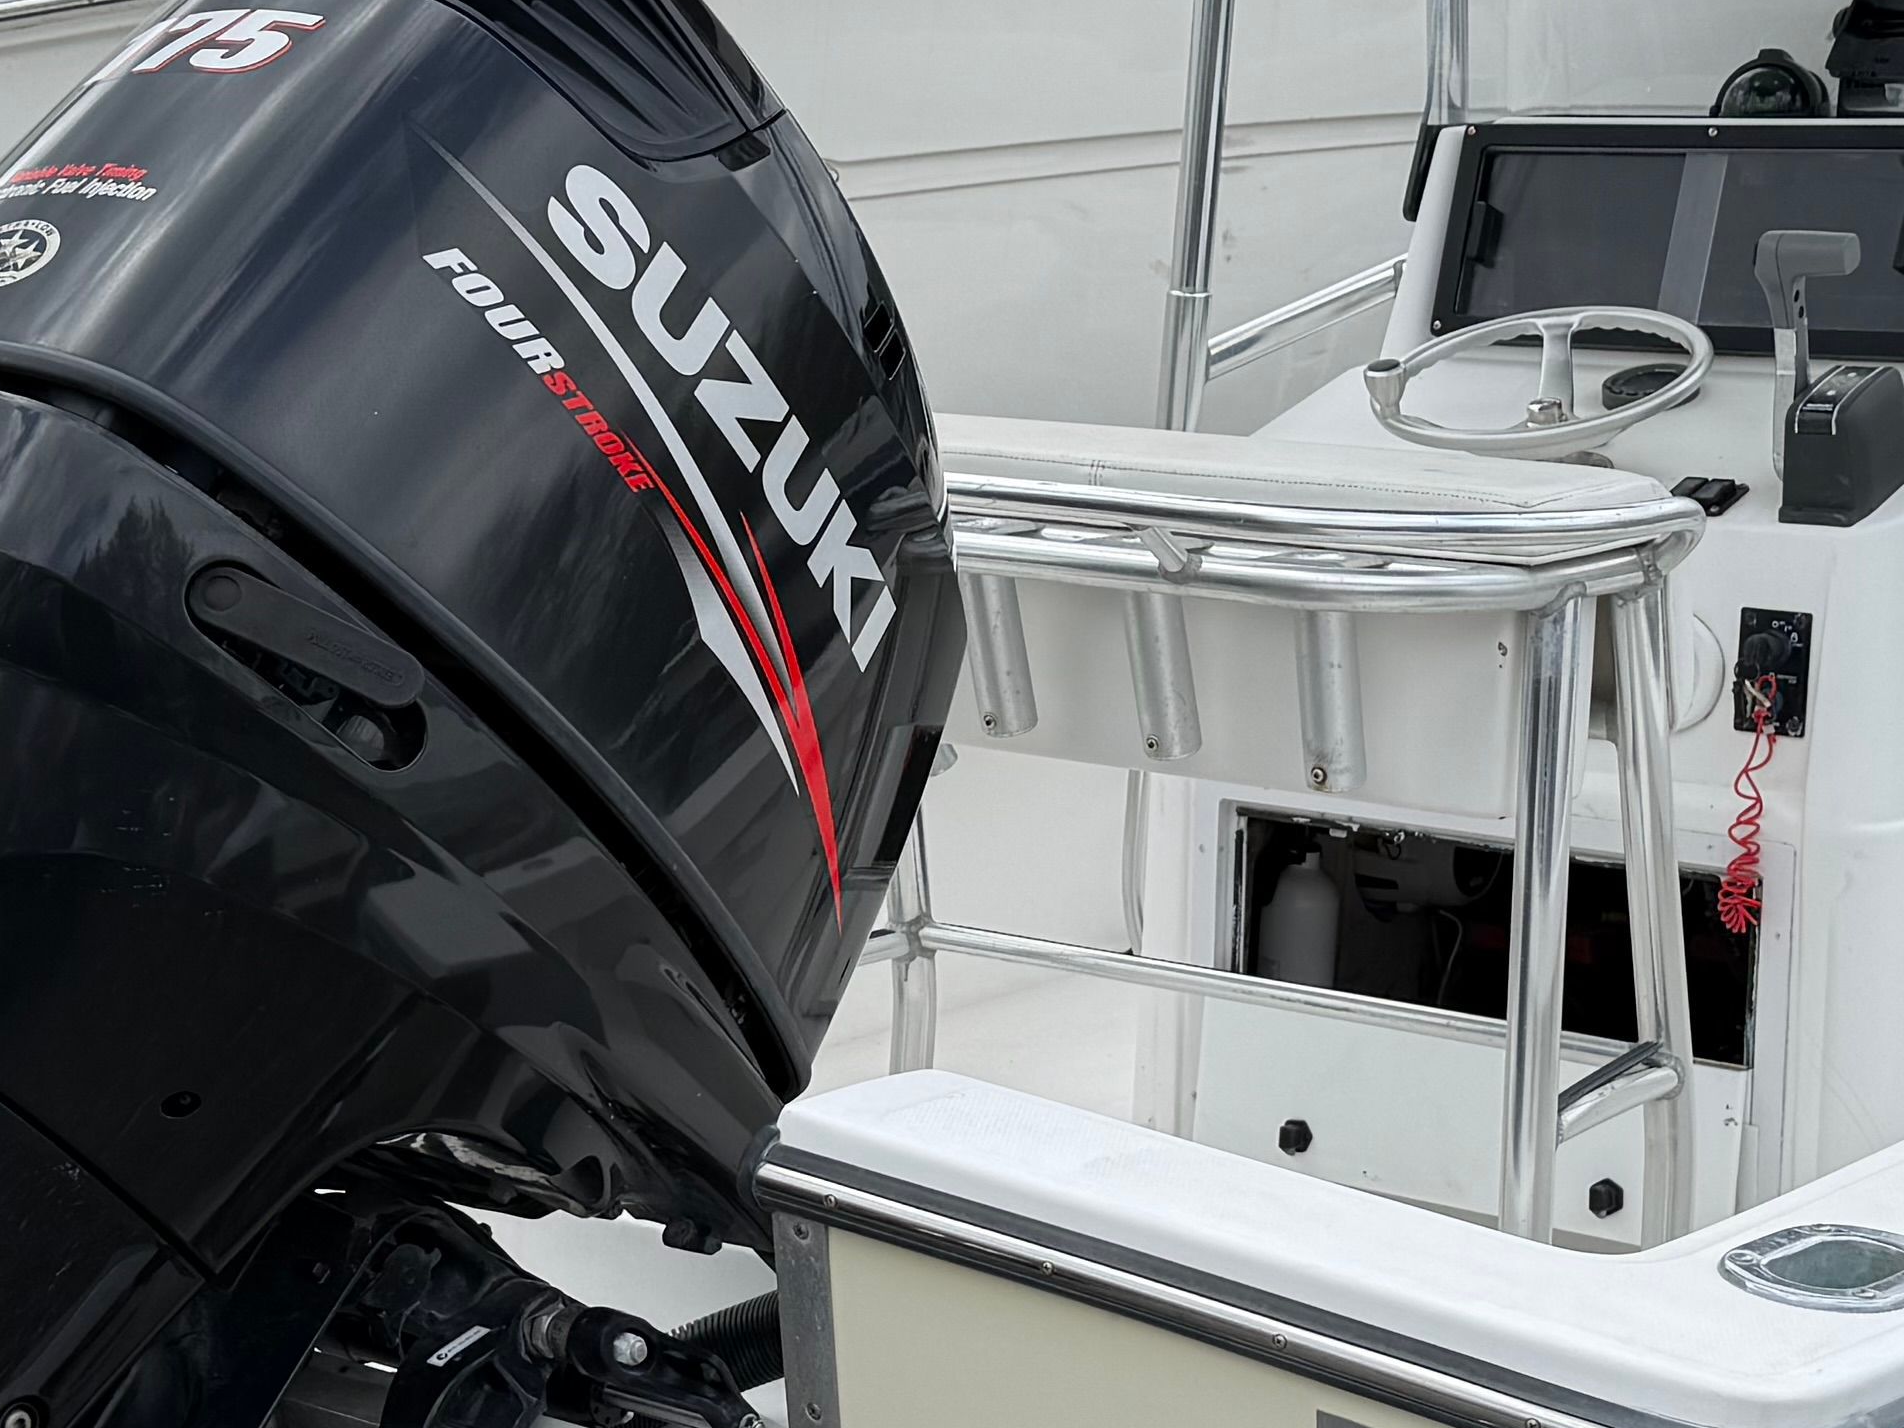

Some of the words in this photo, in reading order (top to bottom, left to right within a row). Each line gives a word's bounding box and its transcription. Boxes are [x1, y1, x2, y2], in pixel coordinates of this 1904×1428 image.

[42, 177, 85, 195] Fuel
[77, 178, 158, 201] Injection
[546, 162, 896, 673] SUZUKI
